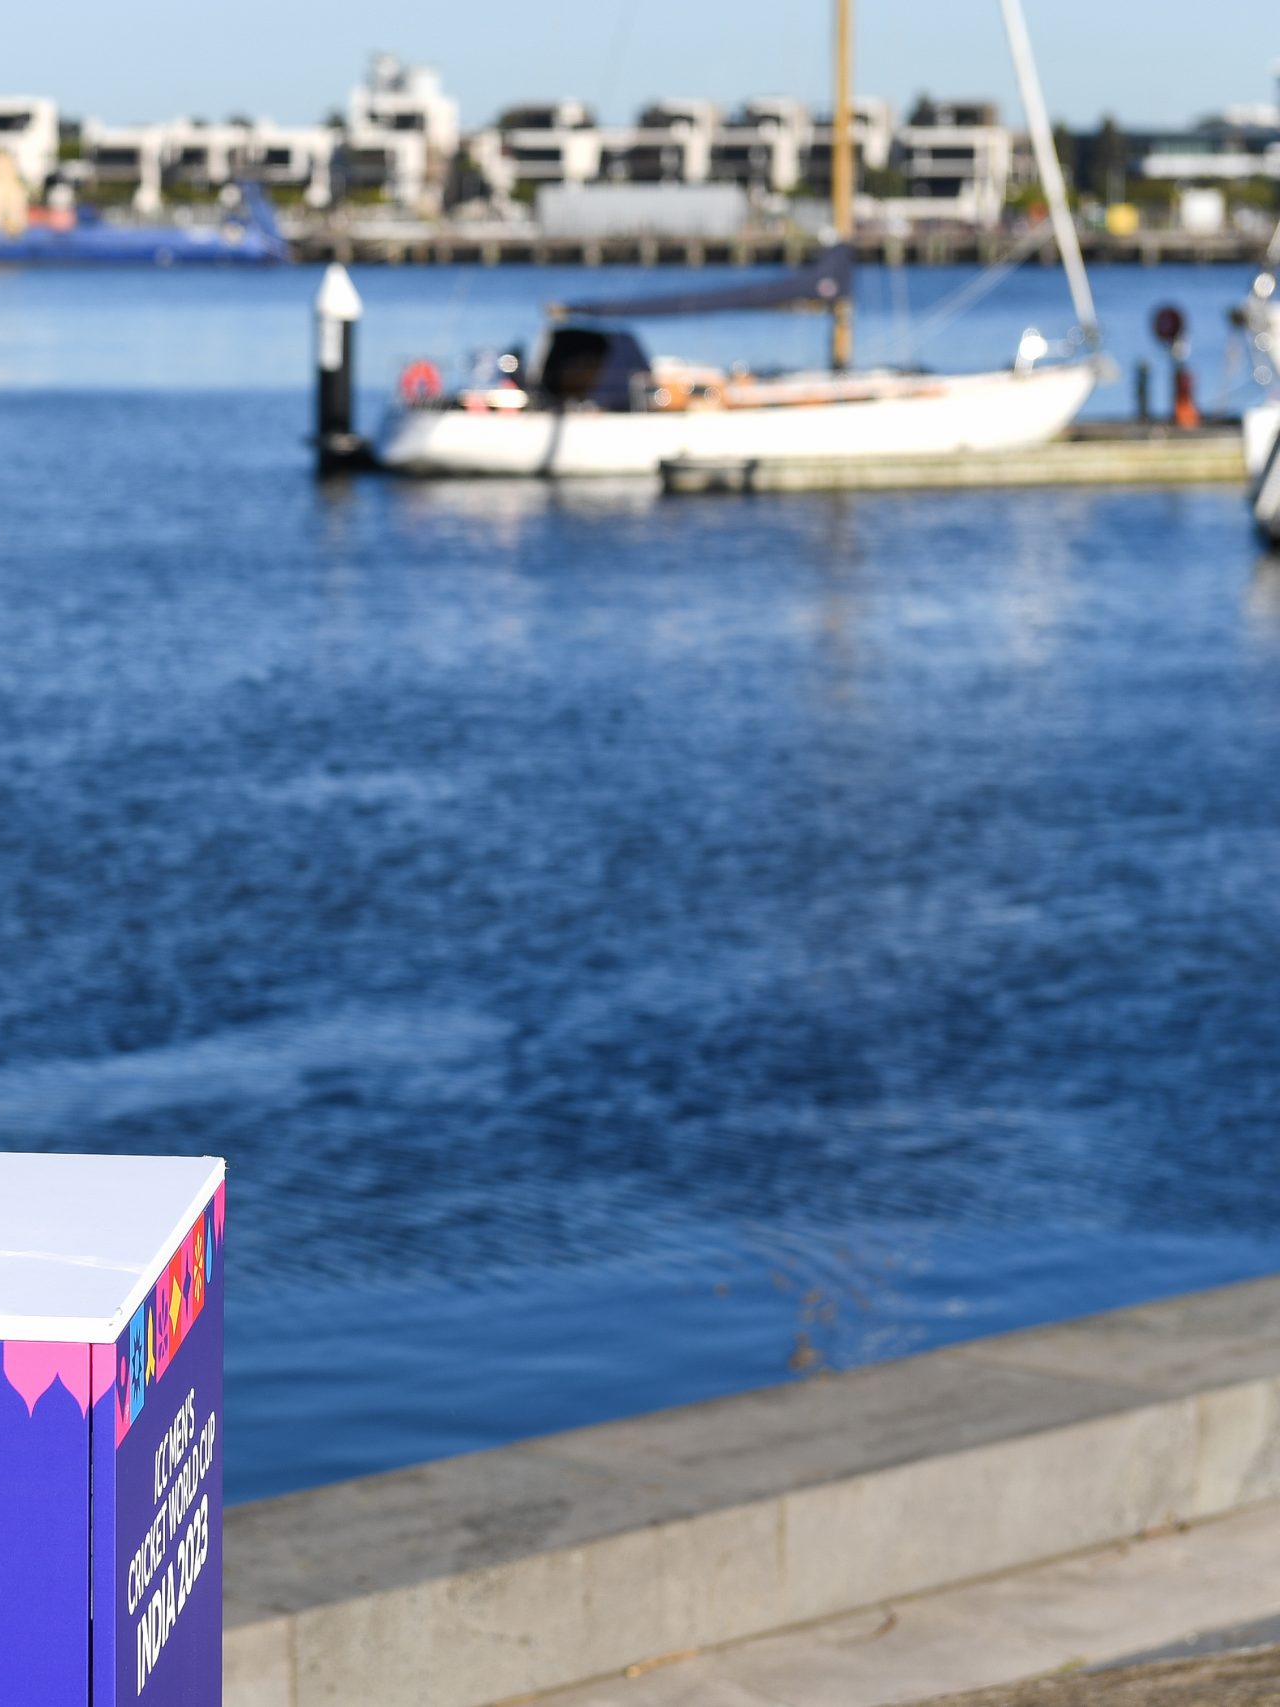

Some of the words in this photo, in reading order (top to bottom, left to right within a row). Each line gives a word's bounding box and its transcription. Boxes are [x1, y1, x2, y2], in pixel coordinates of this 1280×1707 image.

[128, 1500, 168, 1616] CRICKET
[168, 1445, 199, 1541] WORLD
[200, 1411, 216, 1480] CUP
[154, 1432, 169, 1505] ICC
[169, 1388, 195, 1478] MEN'S
[137, 1561, 177, 1697] INDIA
[177, 1493, 209, 1616] 2023
